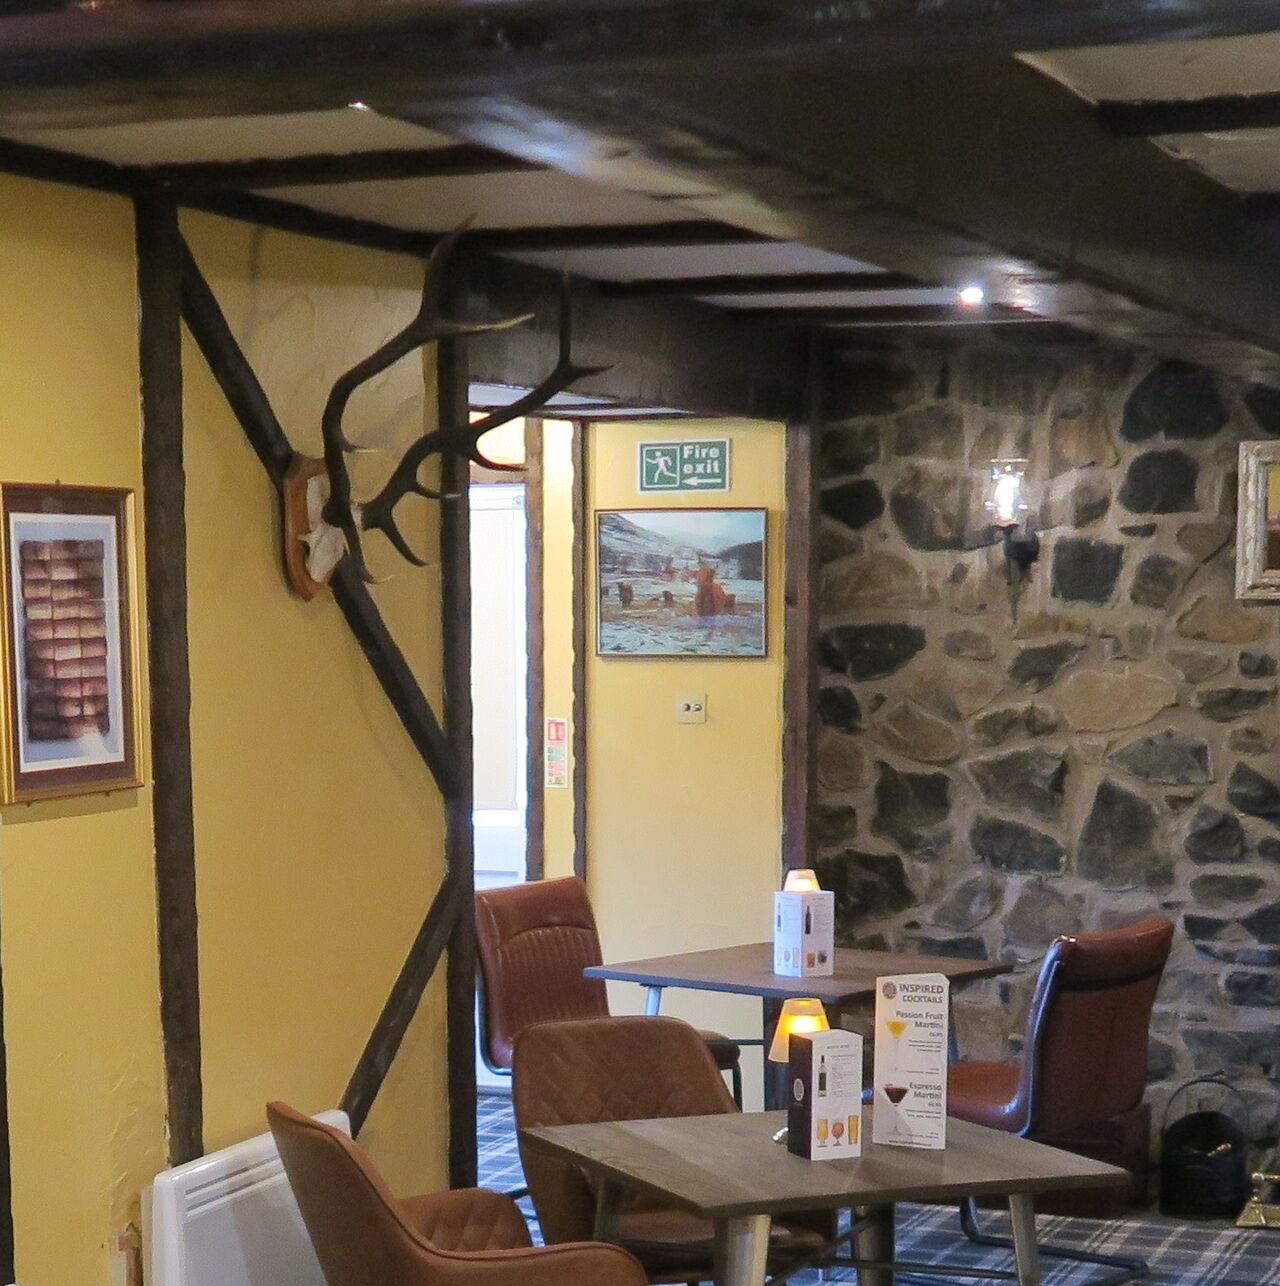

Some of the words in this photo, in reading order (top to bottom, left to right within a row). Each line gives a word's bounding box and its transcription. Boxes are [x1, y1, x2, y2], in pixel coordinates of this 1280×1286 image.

[683, 445, 720, 459] Fire
[683, 460, 720, 474] exit
[899, 983, 944, 994] INSPIRED
[902, 995, 943, 1003] COCKTAILS
[896, 1010, 924, 1019] Passion
[925, 1012, 943, 1020] Fruit
[914, 1021, 944, 1030] Martini
[909, 1082, 942, 1091] Espresso
[913, 1091, 942, 1099] Martini
